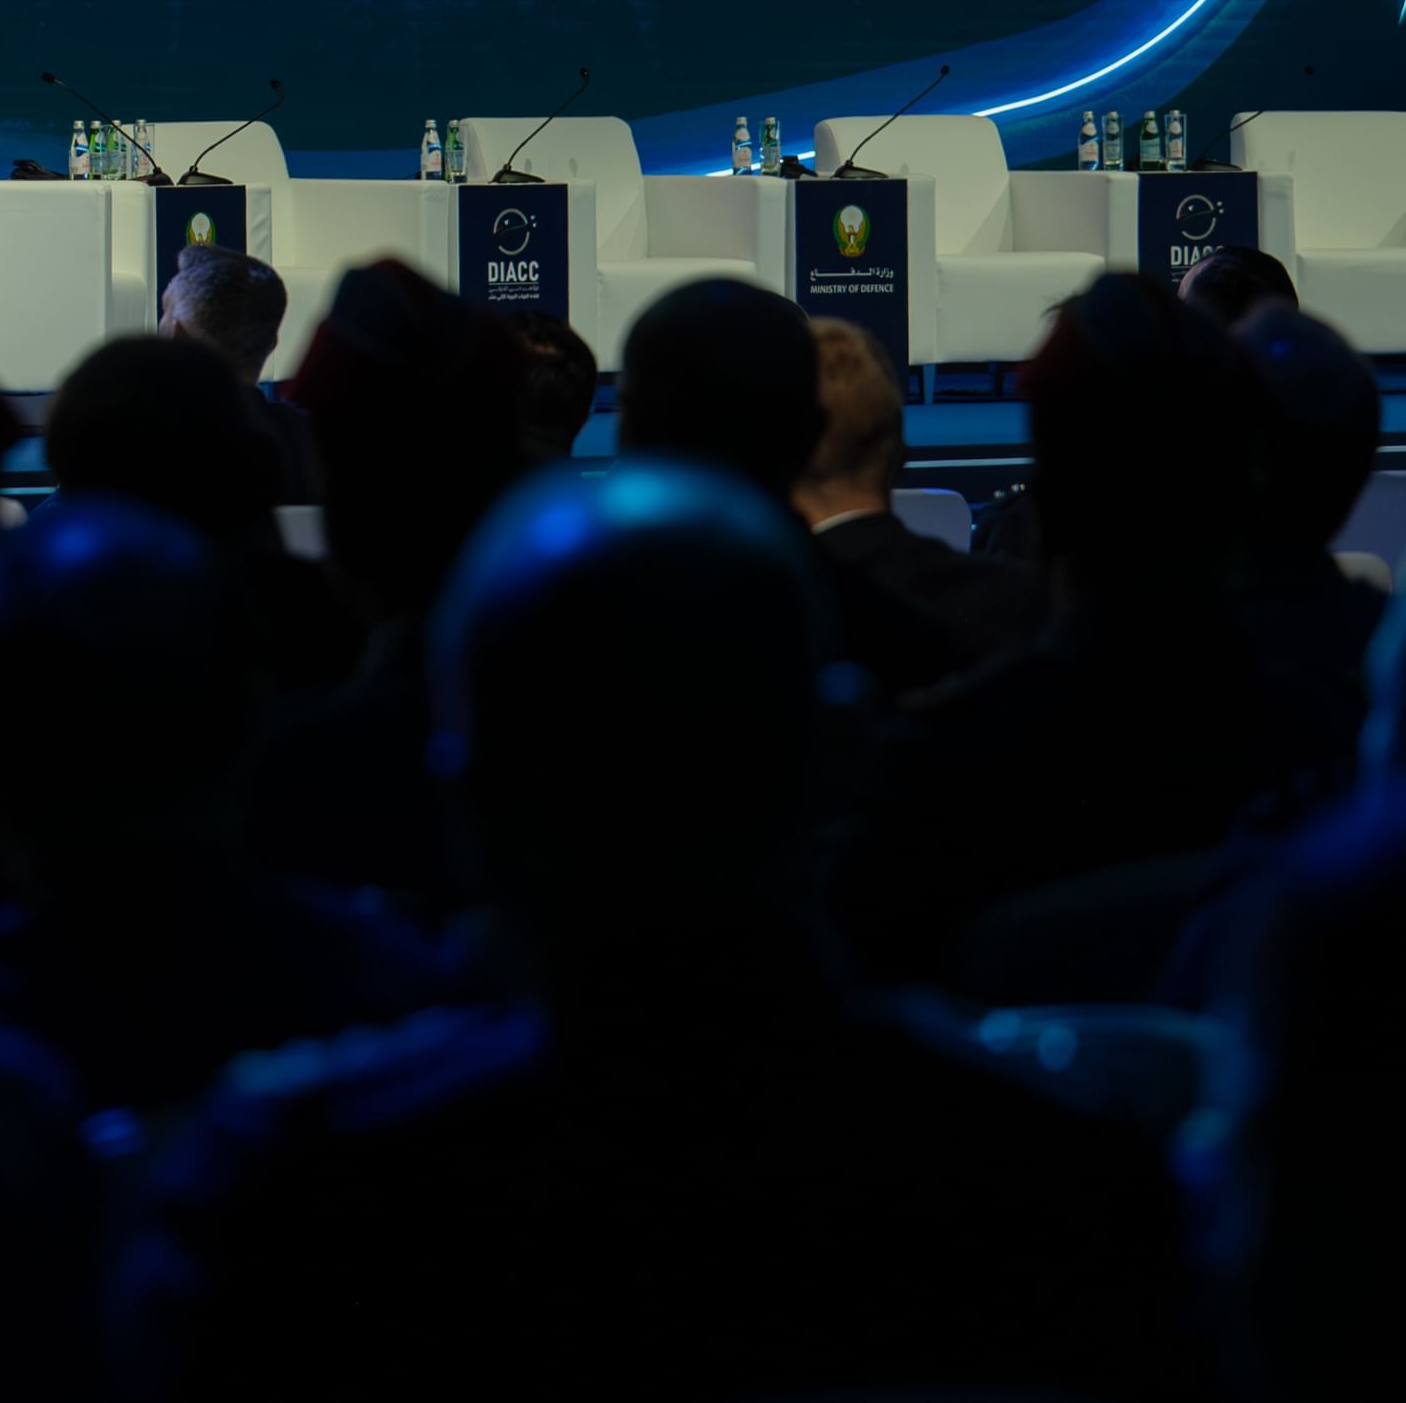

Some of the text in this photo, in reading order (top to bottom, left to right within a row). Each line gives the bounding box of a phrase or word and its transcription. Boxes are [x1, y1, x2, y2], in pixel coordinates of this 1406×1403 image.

[1170, 245, 1225, 266] DIA
[487, 260, 540, 283] DIACC
[810, 283, 894, 294] MINISTRY OF DEFENCE
